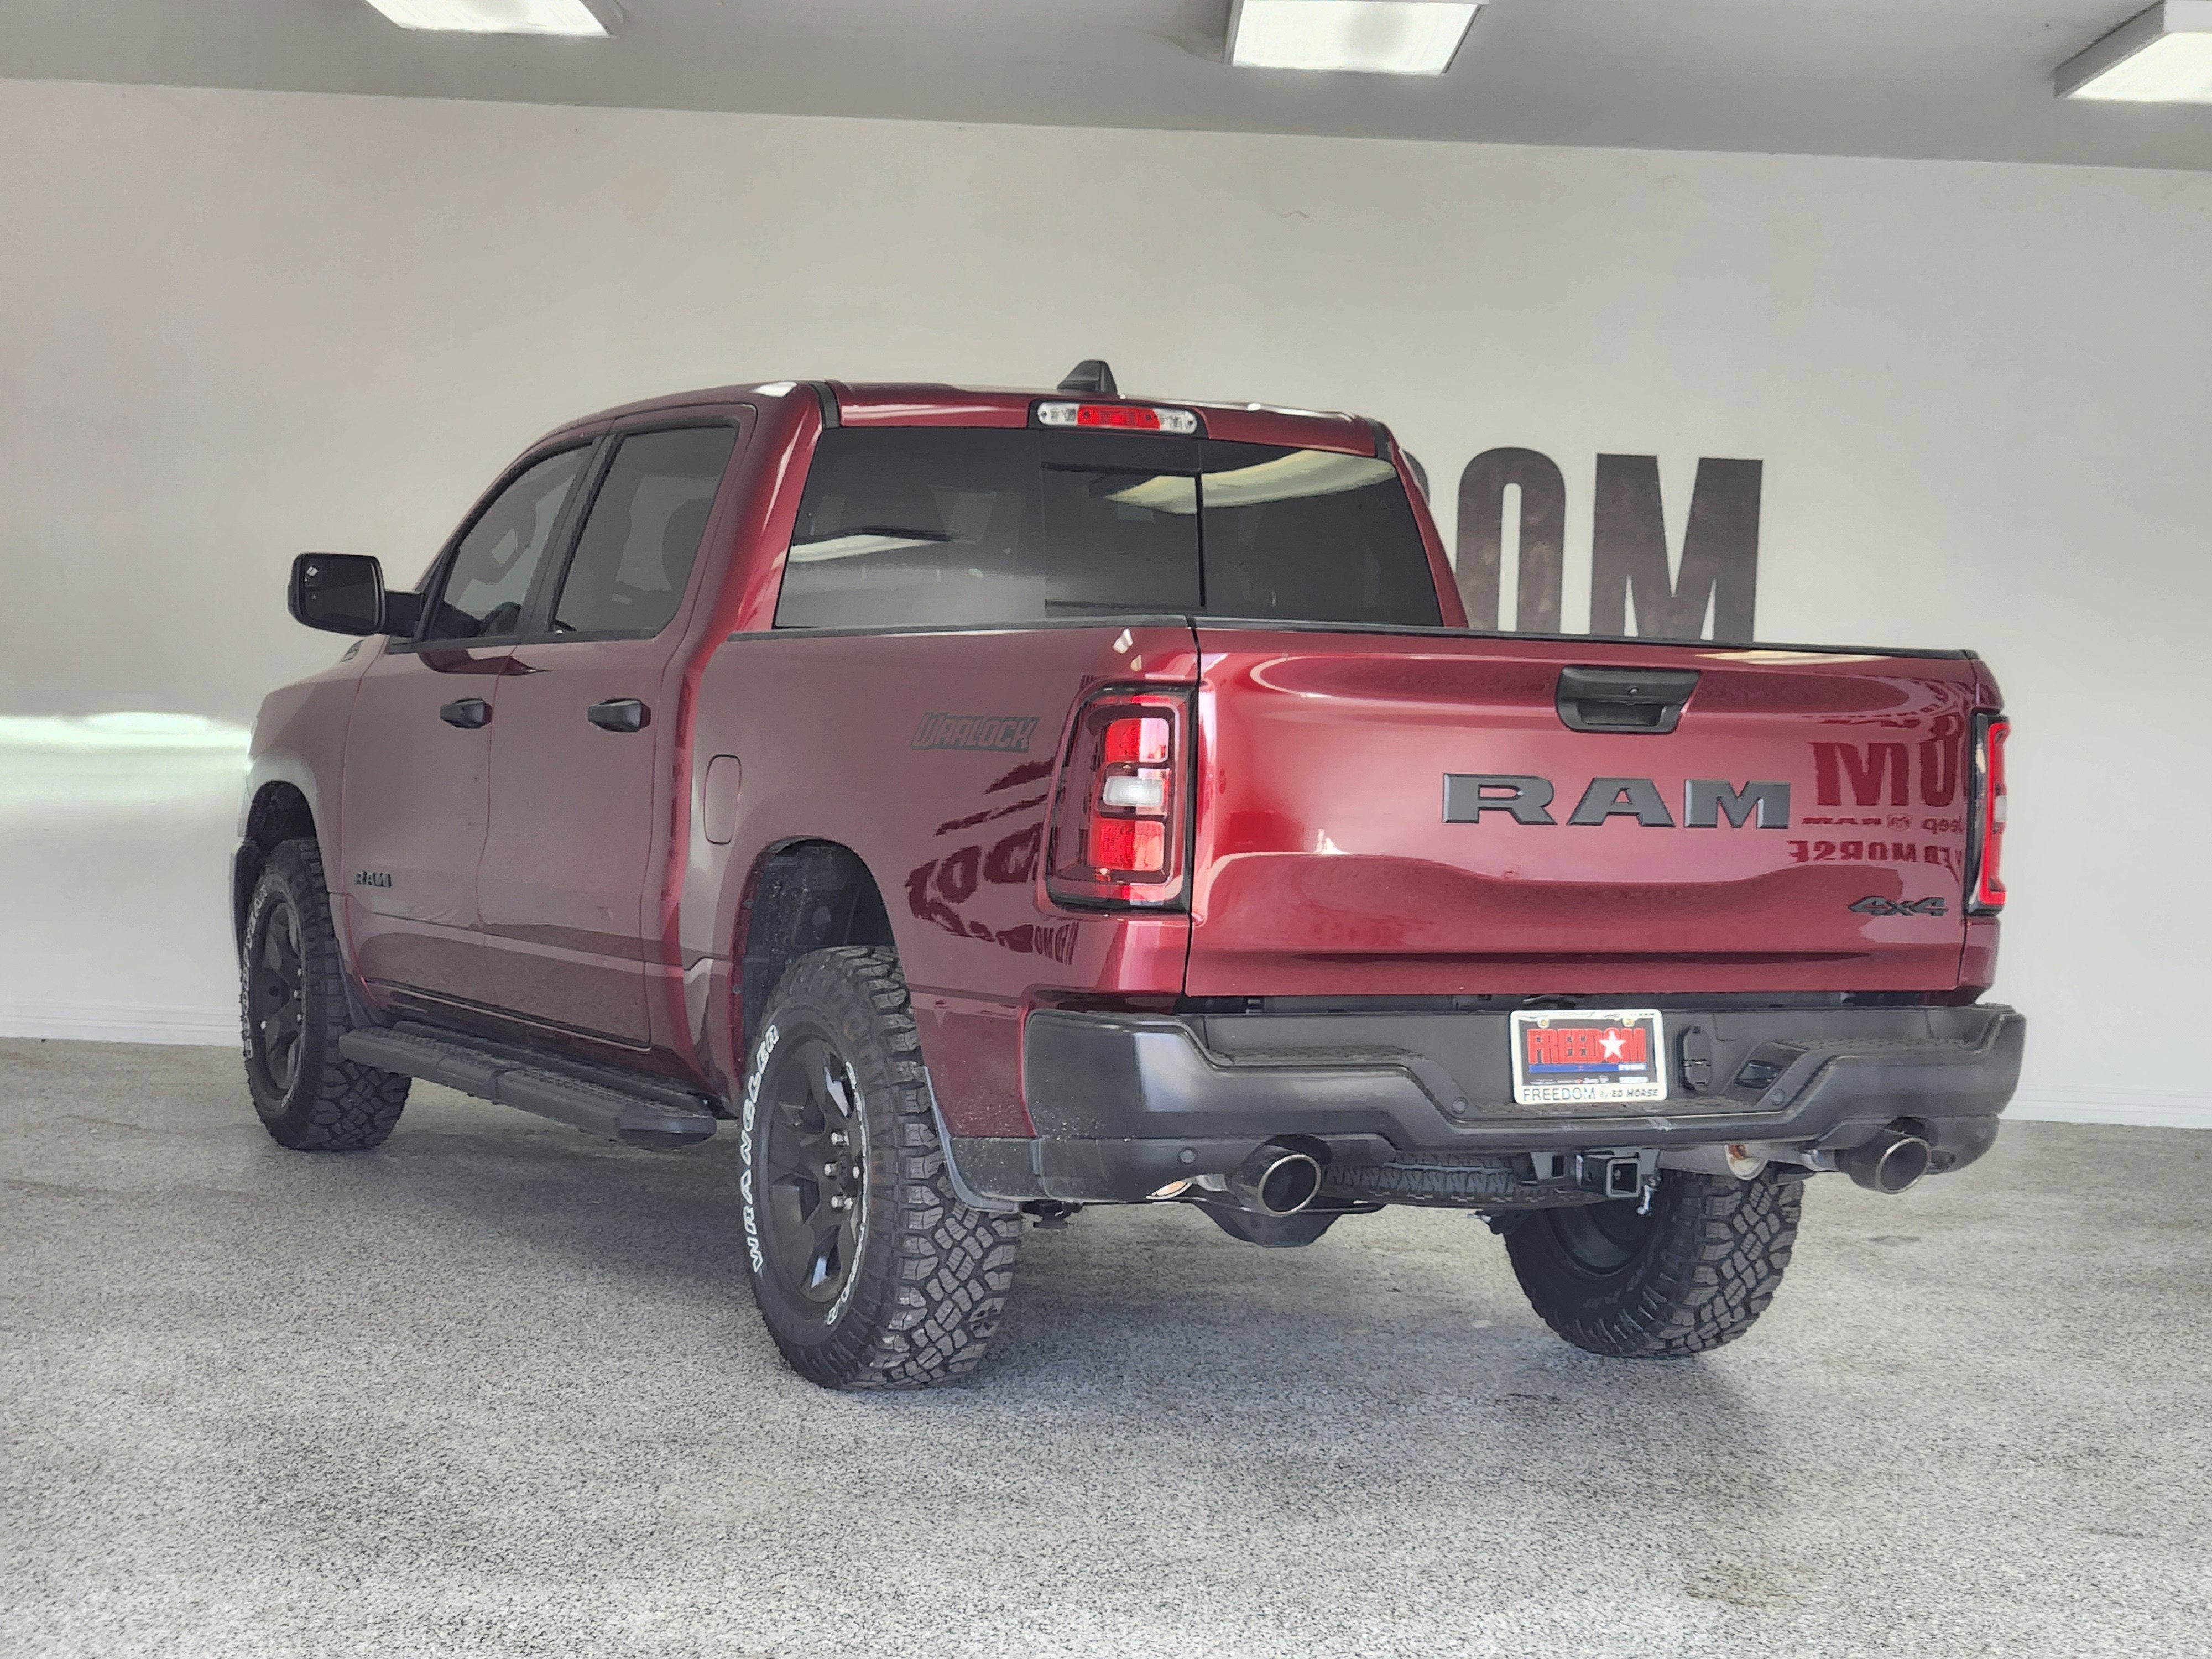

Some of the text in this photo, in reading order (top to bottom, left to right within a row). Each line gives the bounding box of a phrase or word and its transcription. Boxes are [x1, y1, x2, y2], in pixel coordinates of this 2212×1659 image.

[1400, 447, 1763, 643] OM
[911, 712, 1040, 753] WARLOCK
[1442, 773, 1790, 829] RAM
[355, 871, 393, 889] RAM
[1523, 1087, 1596, 1102] FREEDOM
[740, 1025, 780, 1272] WRANGLER
